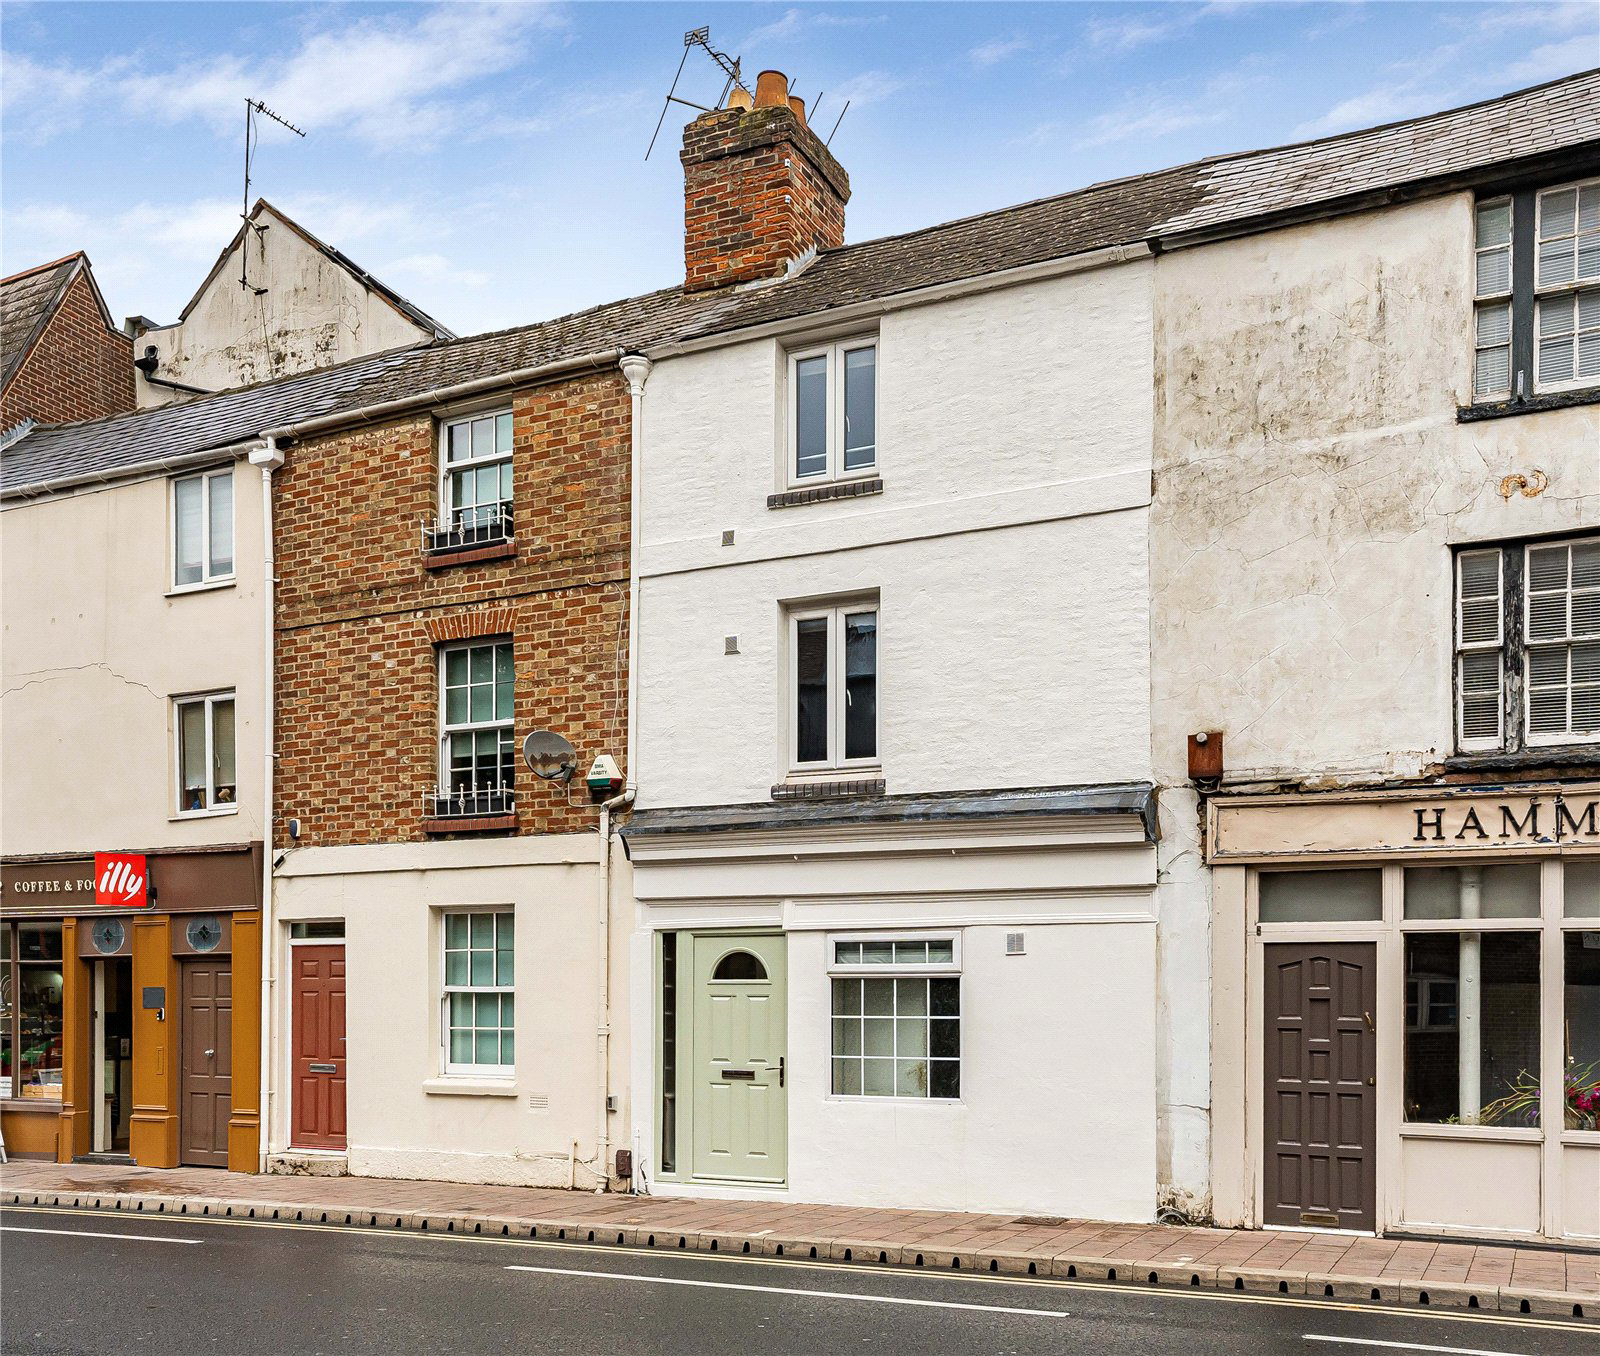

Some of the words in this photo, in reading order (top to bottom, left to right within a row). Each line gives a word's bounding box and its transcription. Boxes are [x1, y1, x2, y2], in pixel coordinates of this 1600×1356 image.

[1413, 800, 1600, 841] HAMM
[14, 880, 61, 893] COFFEE
[64, 880, 73, 892] &
[99, 861, 143, 902] illy
